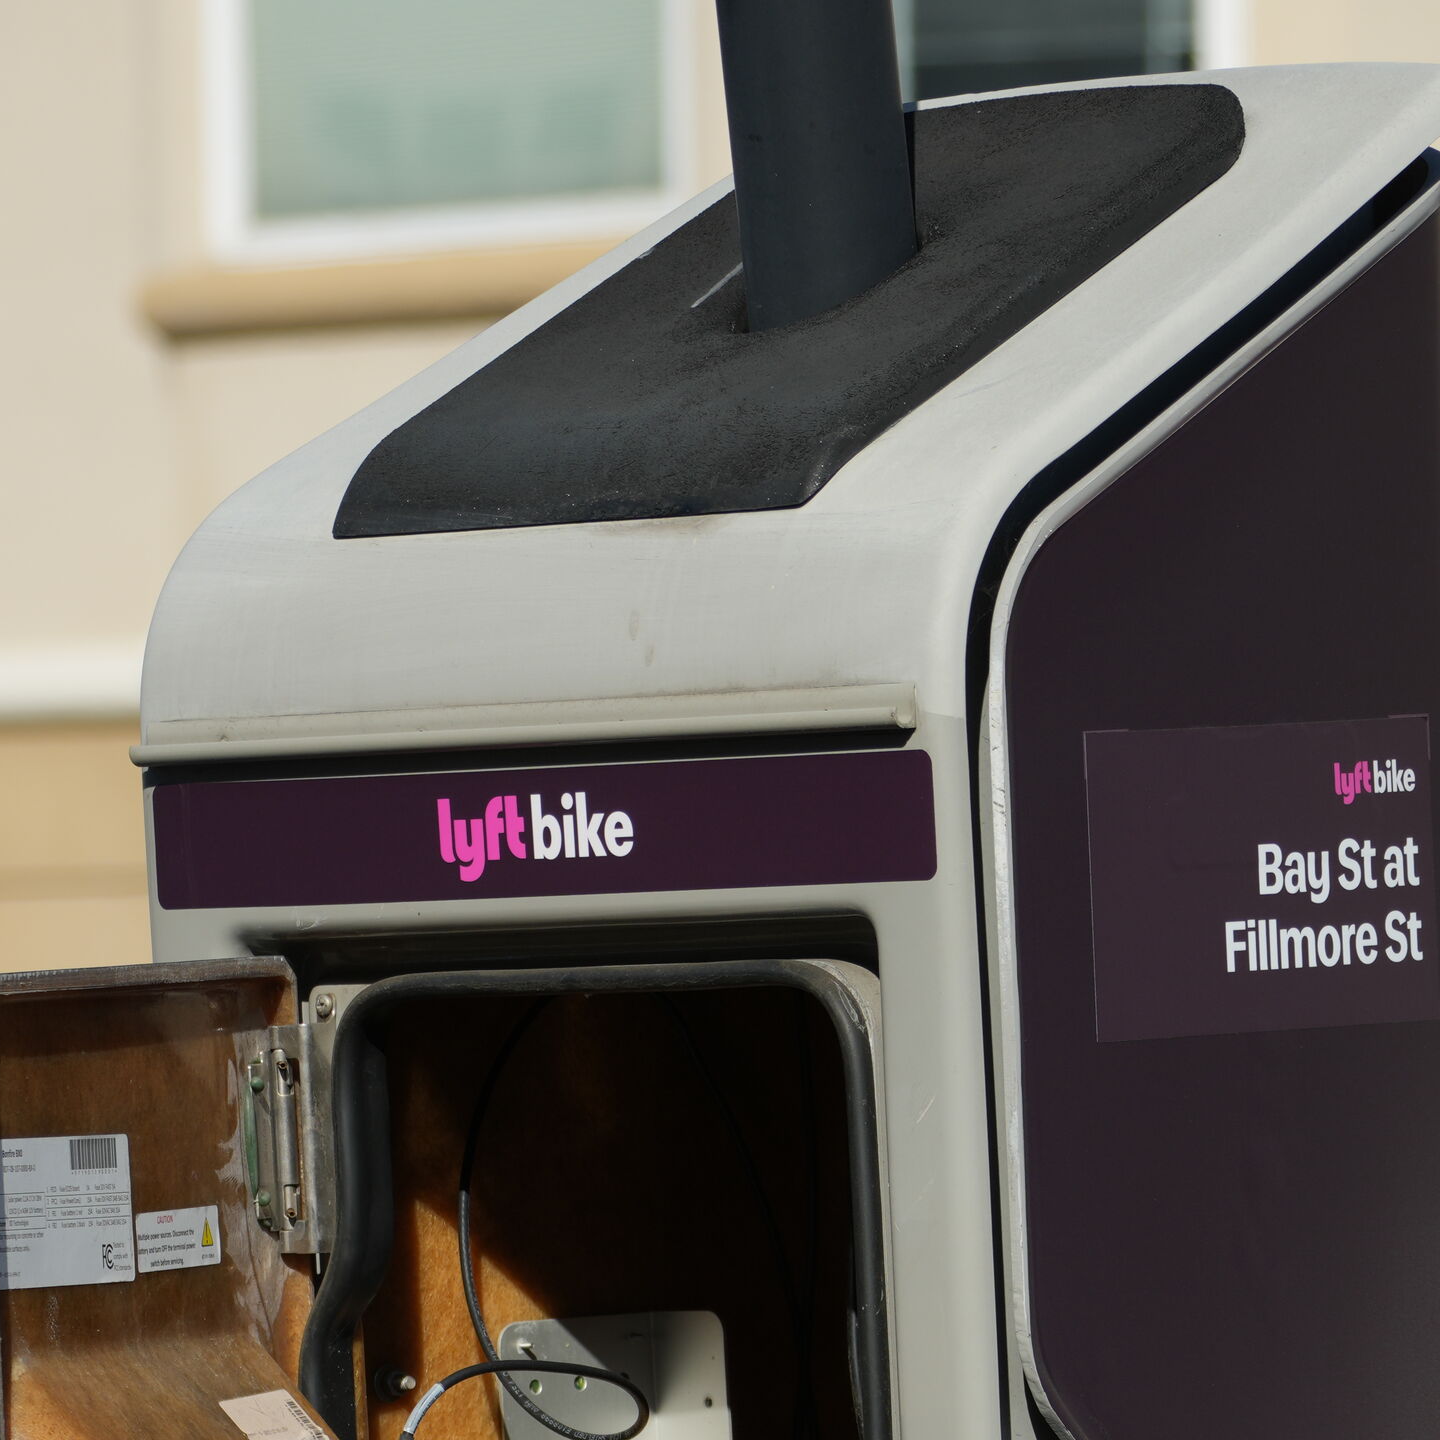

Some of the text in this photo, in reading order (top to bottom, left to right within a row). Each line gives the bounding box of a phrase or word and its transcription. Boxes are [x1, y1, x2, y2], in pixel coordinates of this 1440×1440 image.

[1333, 759, 1416, 805] lyft bike
[437, 791, 634, 882] lyft bike
[1258, 836, 1420, 904] Bay St at
[1225, 909, 1424, 973] Fillmore St
